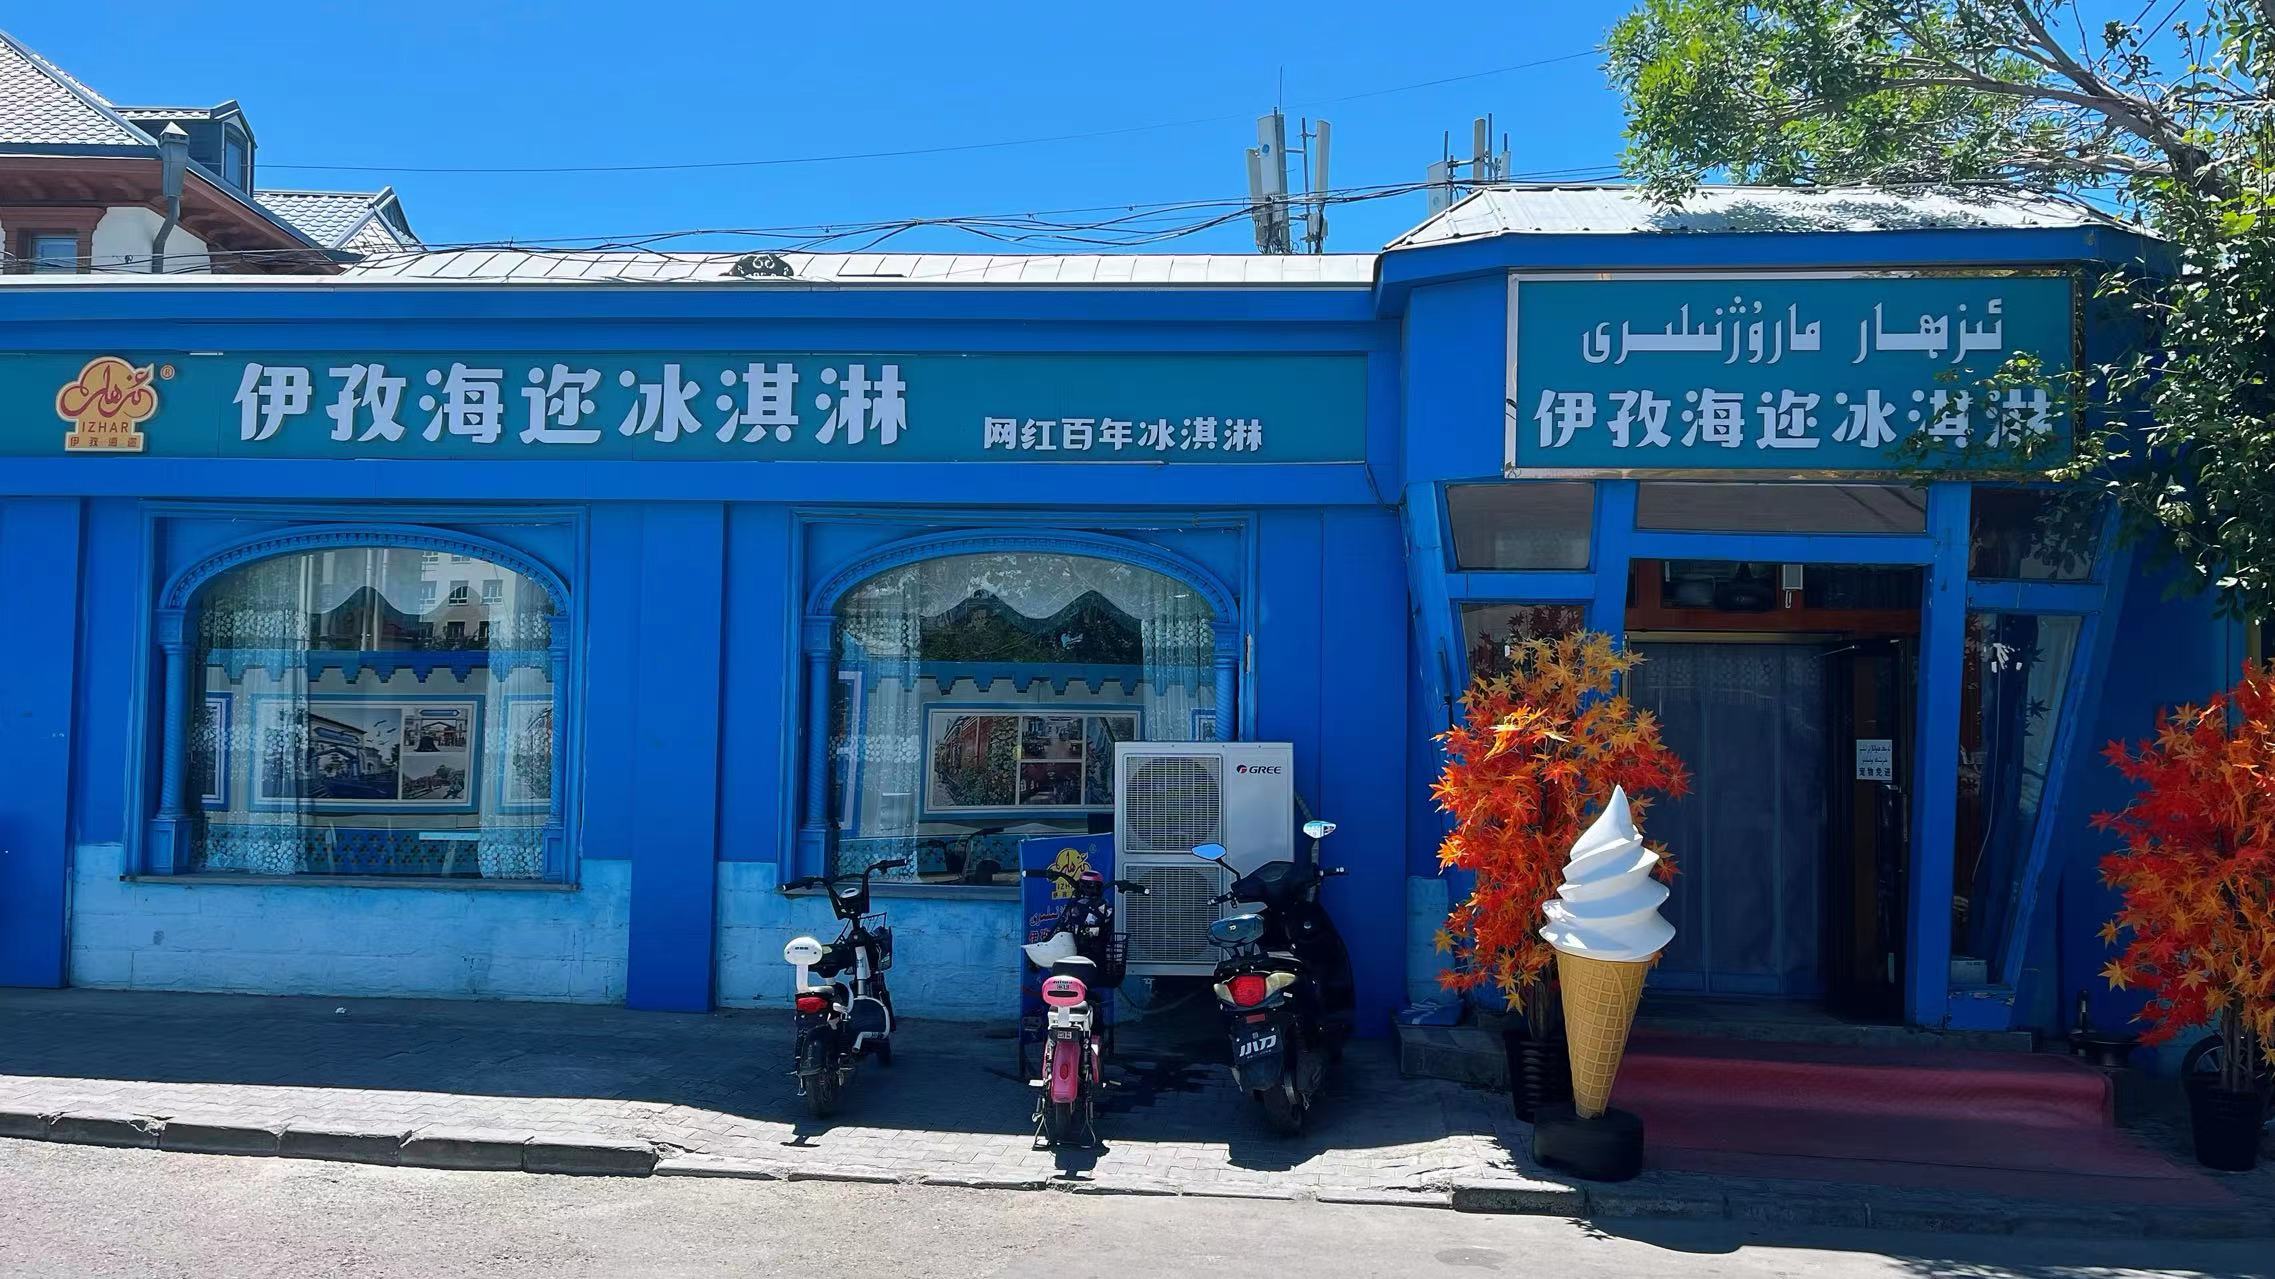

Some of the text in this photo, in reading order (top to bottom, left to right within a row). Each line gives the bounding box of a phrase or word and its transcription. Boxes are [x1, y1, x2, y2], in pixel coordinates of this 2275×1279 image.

[231, 362, 907, 446] 伊孜海迩冰淇淋
[81, 421, 129, 433] IZHAR
[984, 416, 1263, 451] 网红百年冰淇淋
[1249, 765, 1282, 775] GREE
